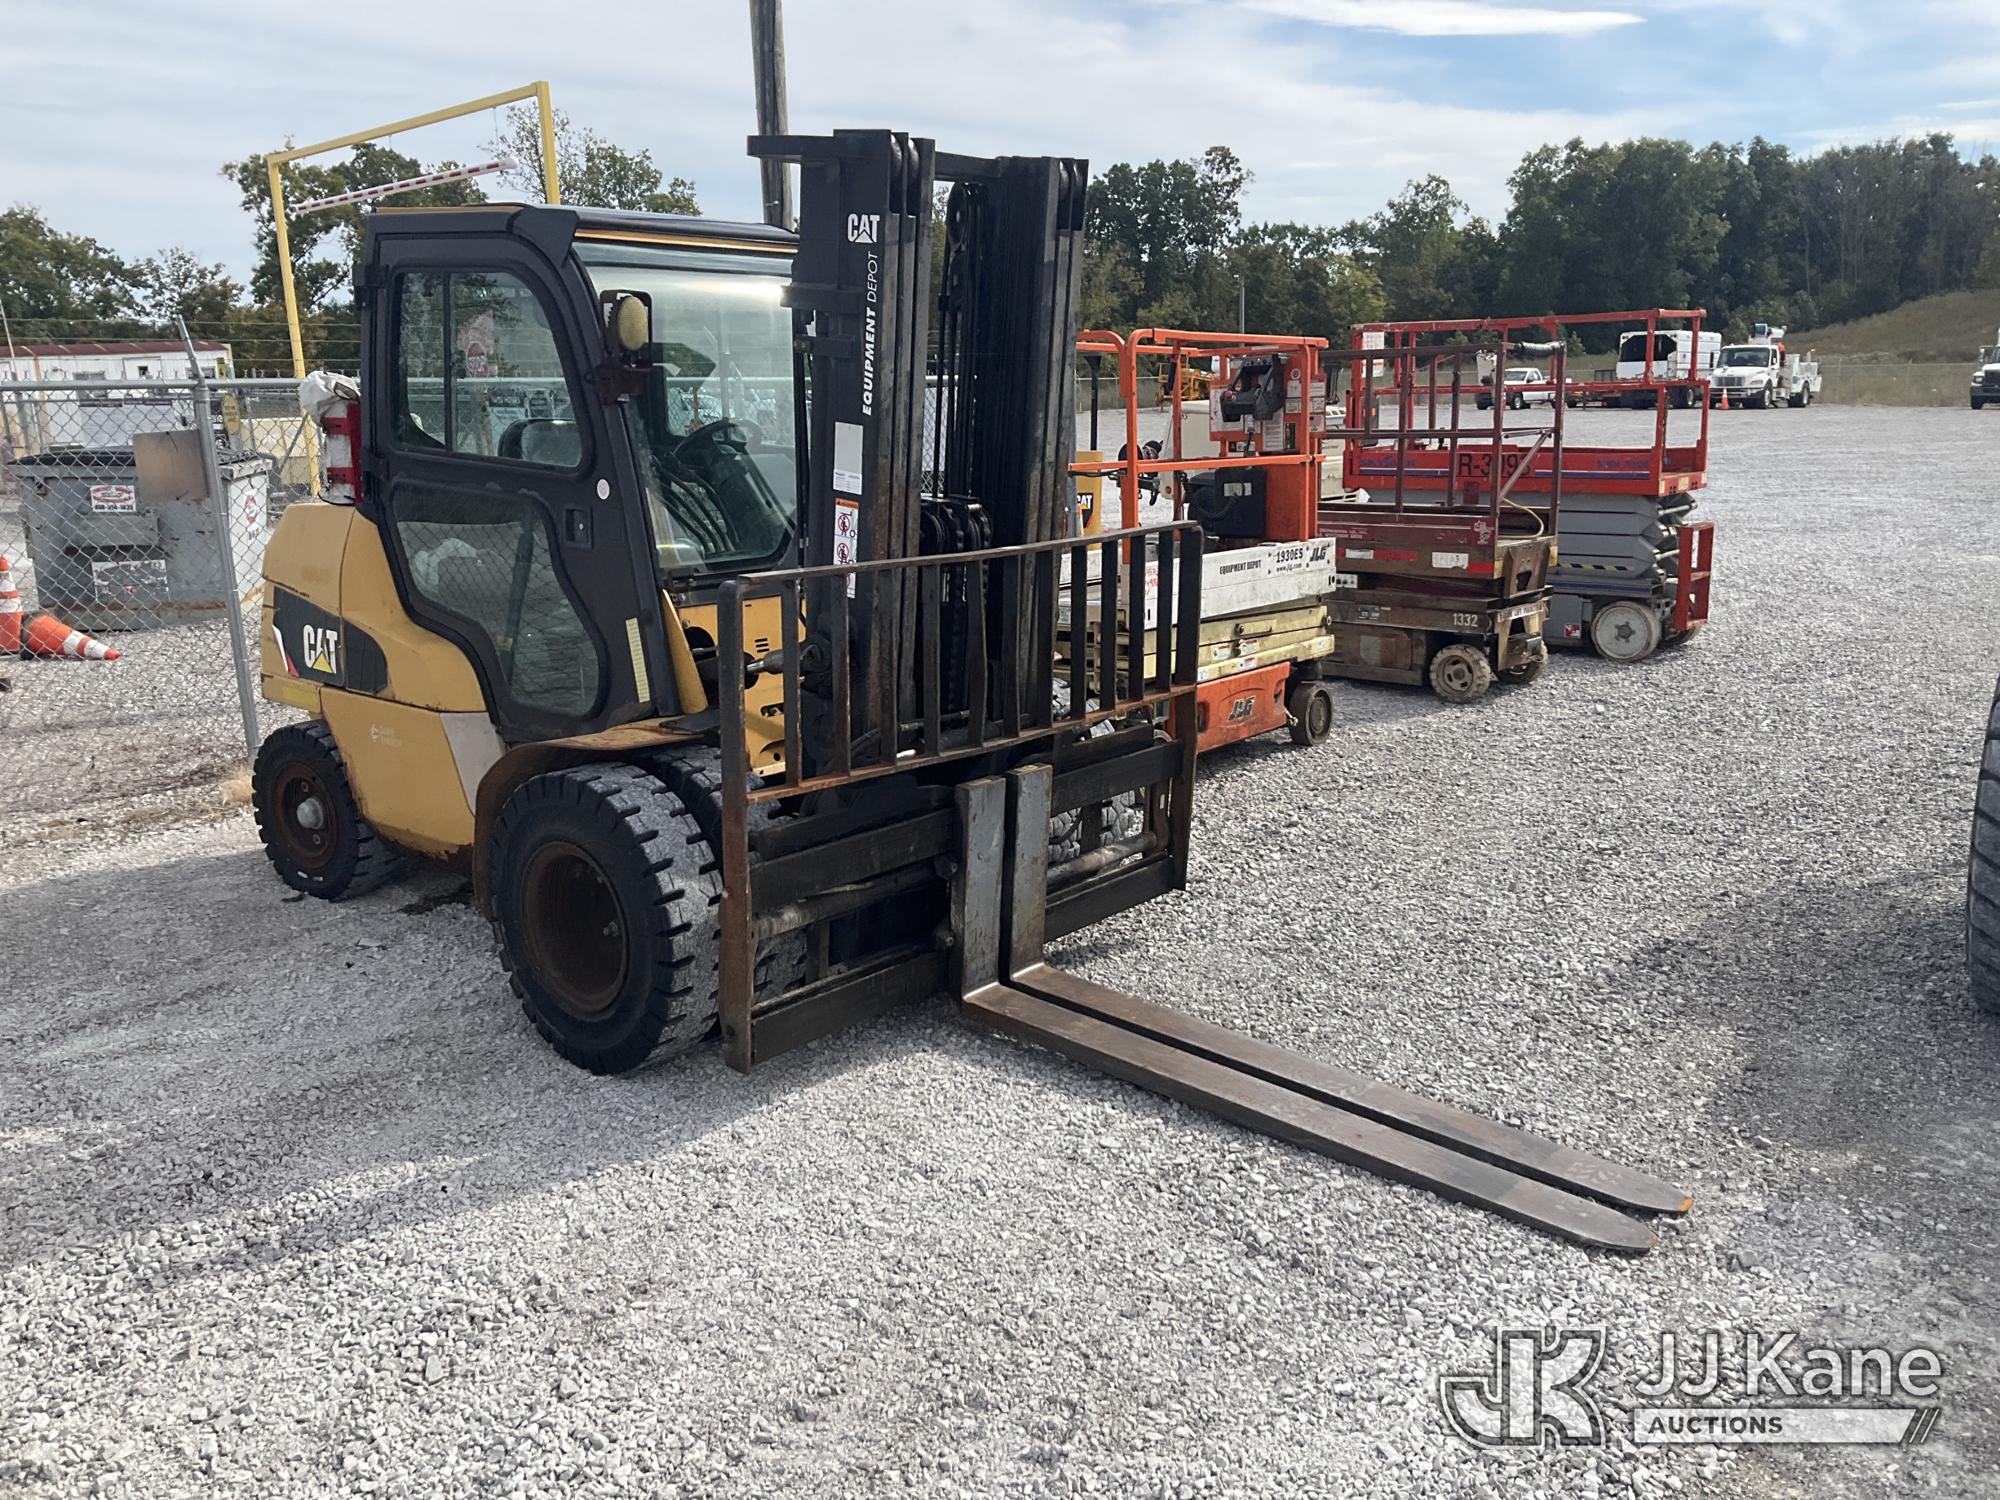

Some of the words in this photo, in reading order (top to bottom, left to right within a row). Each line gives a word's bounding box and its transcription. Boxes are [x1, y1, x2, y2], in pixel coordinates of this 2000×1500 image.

[848, 213, 880, 243] CAT
[867, 251, 878, 303] DEPOT
[862, 307, 876, 416] EQUIPMENT
[1276, 548, 1304, 563] 1930ES
[1310, 545, 1327, 562] JLG
[1220, 562, 1246, 575] EQUIPMENT
[1247, 560, 1262, 570] DEPOT
[1453, 612, 1479, 628] 1332
[303, 624, 339, 674] CAT
